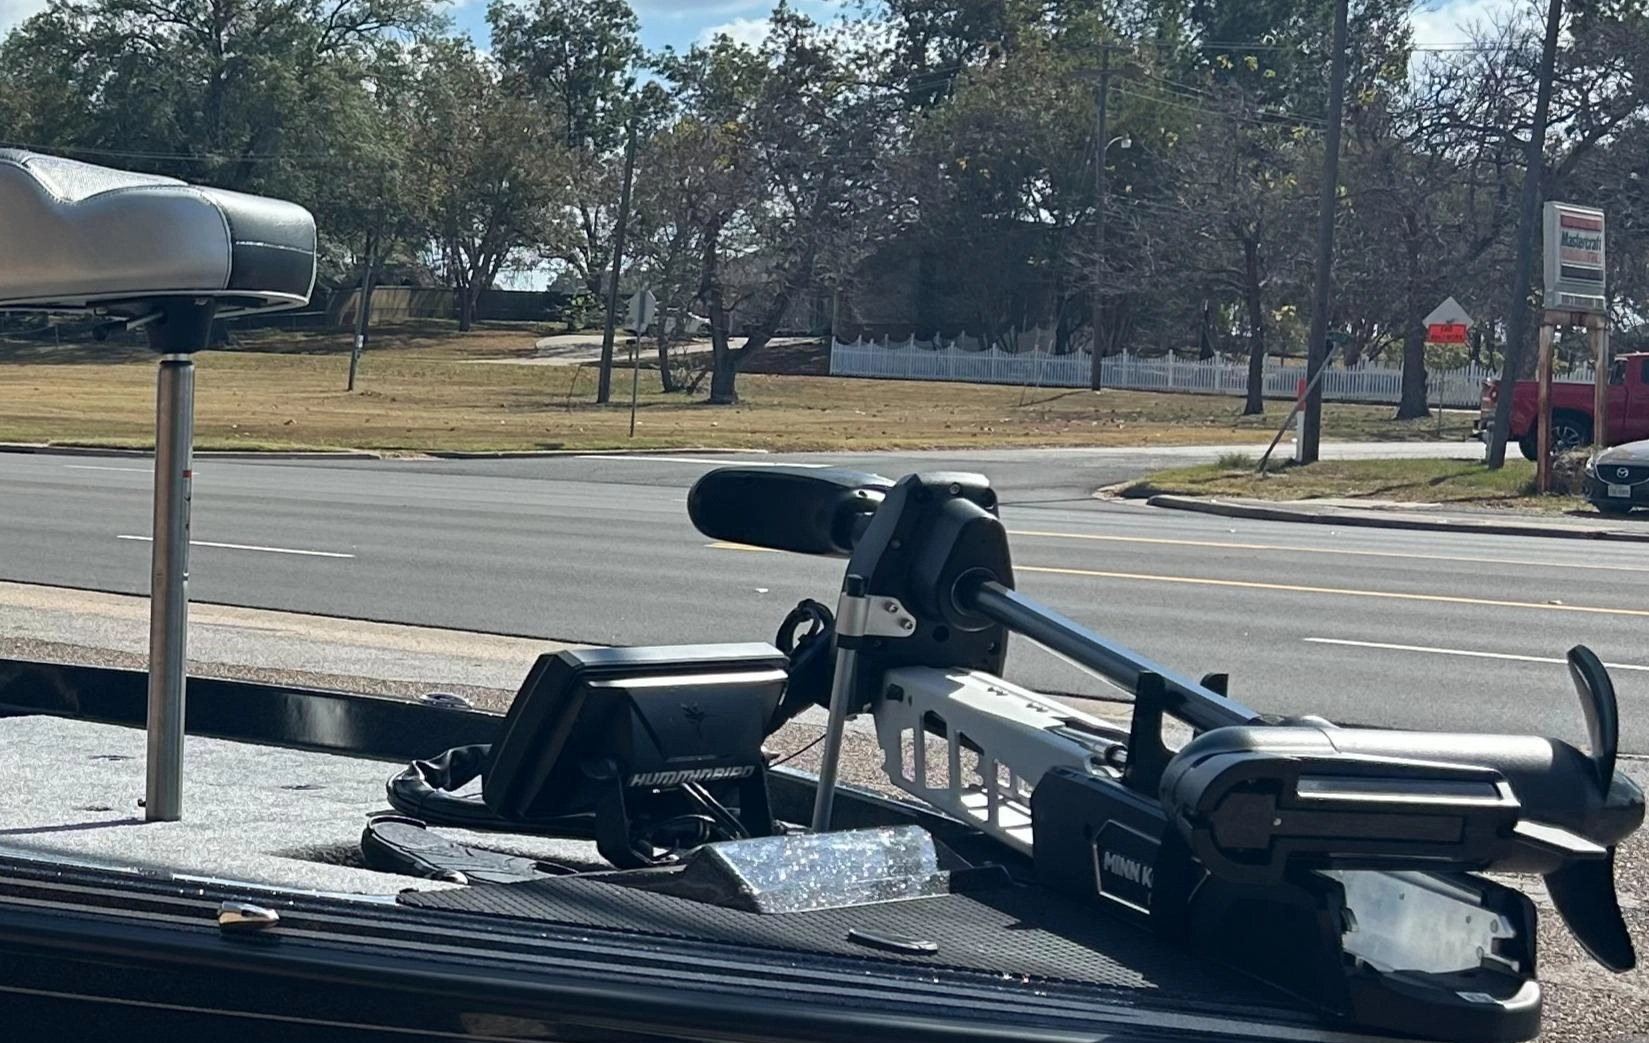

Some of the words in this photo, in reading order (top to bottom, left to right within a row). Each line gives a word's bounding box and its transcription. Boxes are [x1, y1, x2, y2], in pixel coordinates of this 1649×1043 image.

[1561, 230, 1602, 251] Mastercraft
[630, 765, 755, 787] HUMMINBIRD
[1103, 850, 1140, 883] MINN
